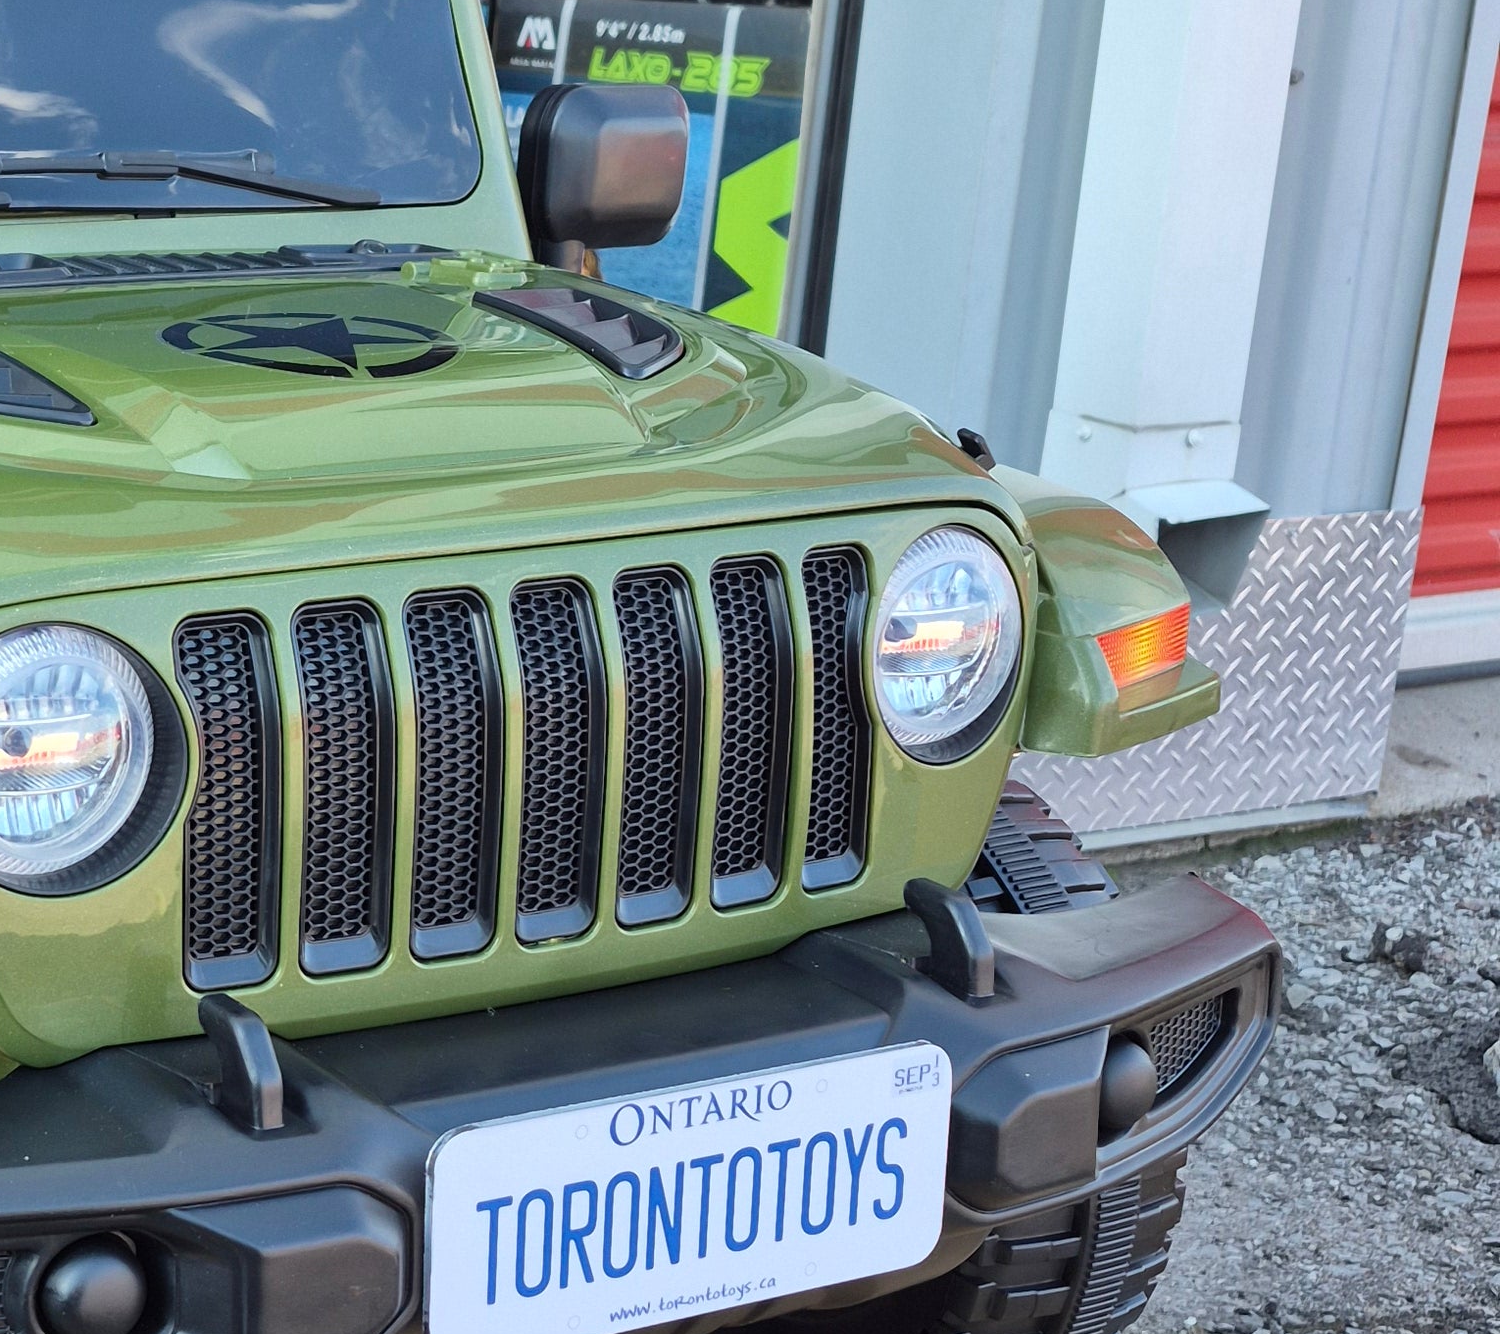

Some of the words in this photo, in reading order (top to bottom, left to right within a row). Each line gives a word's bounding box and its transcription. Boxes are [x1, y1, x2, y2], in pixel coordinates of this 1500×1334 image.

[894, 1063, 931, 1088] SEP
[608, 1079, 793, 1147] ONTARIO
[476, 1116, 908, 1306] TORONTOTOYS
